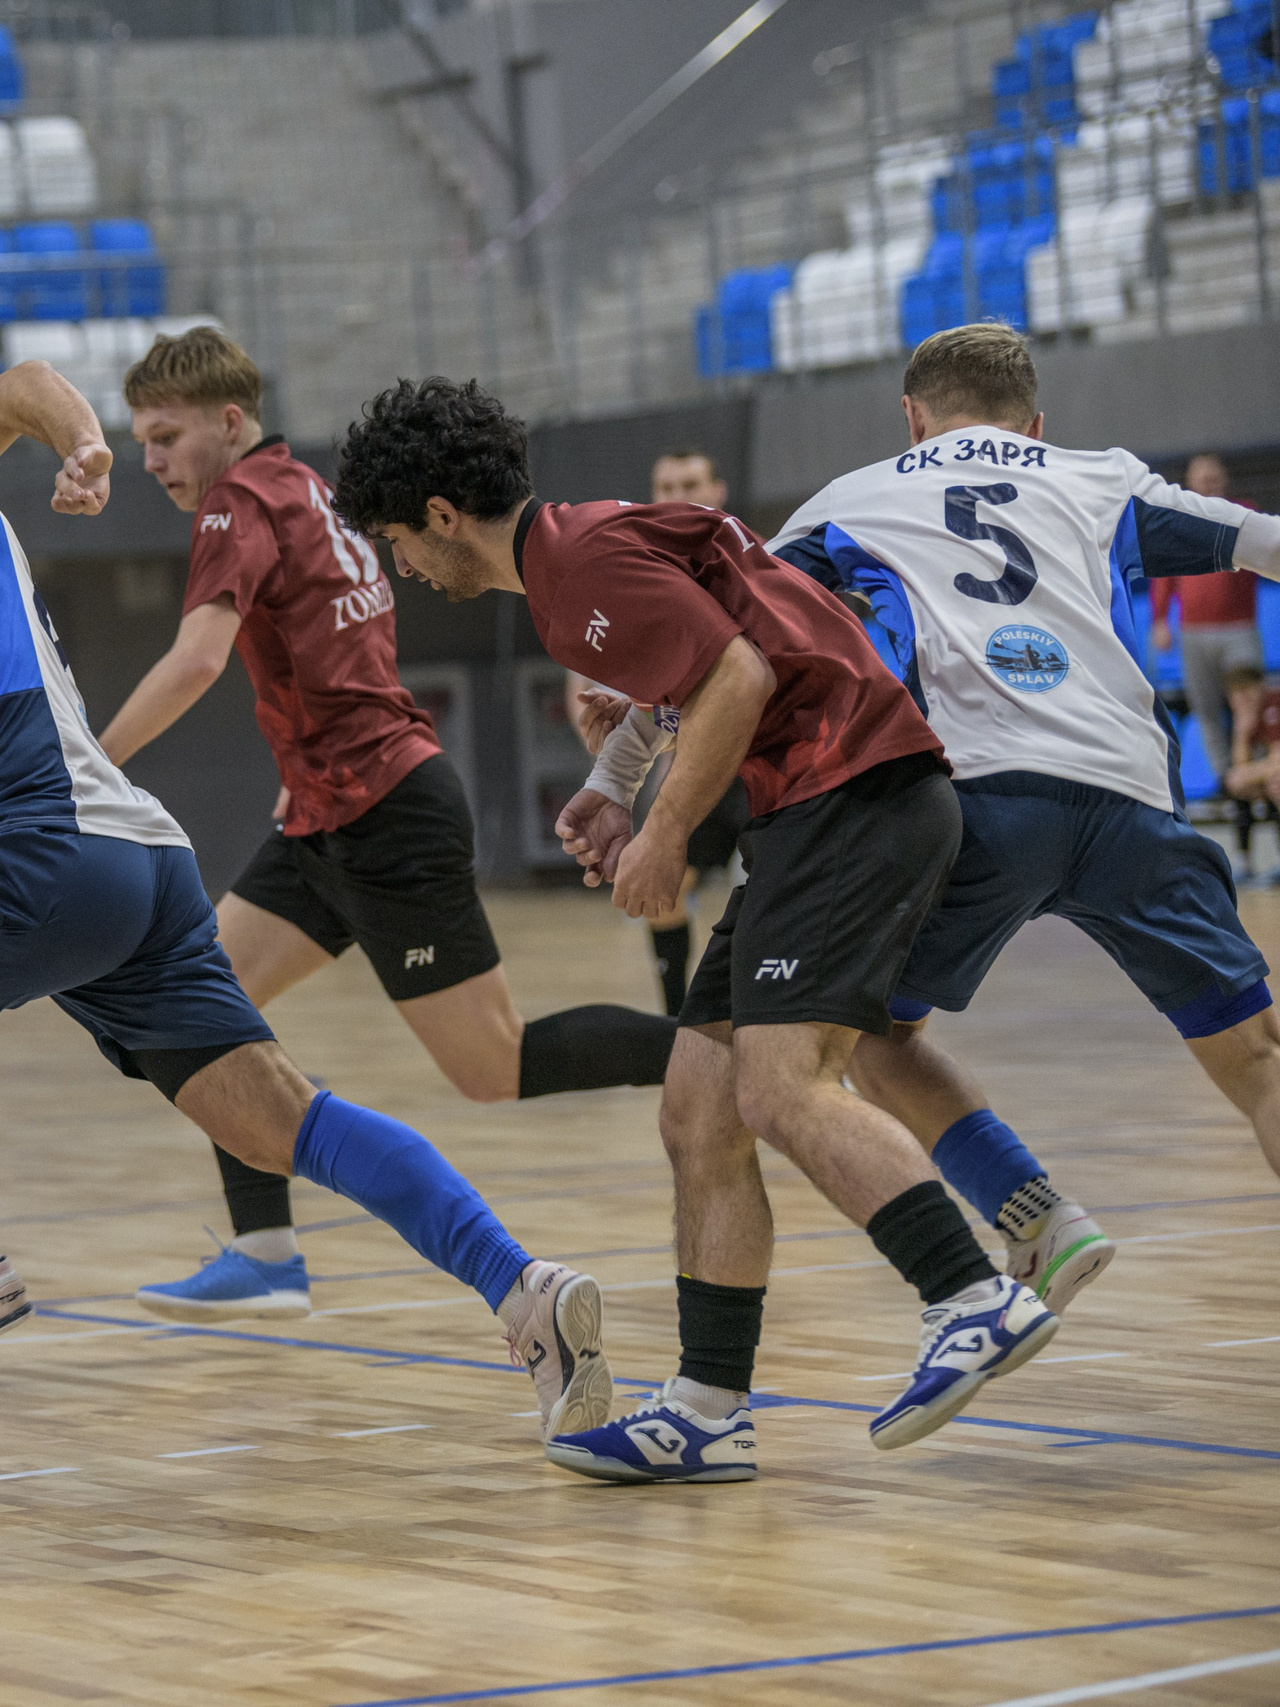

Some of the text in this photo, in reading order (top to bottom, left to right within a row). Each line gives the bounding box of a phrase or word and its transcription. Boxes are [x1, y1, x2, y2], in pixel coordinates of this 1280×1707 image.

[896, 438, 1047, 474] СК ЗАРЯ
[200, 511, 233, 535] FN
[945, 482, 1039, 606] 5
[585, 608, 610, 652] FN
[994, 631, 1056, 646] POLESKIY
[1007, 673, 1055, 685] SPLAV
[404, 944, 435, 970] FN
[754, 959, 800, 980] FN
